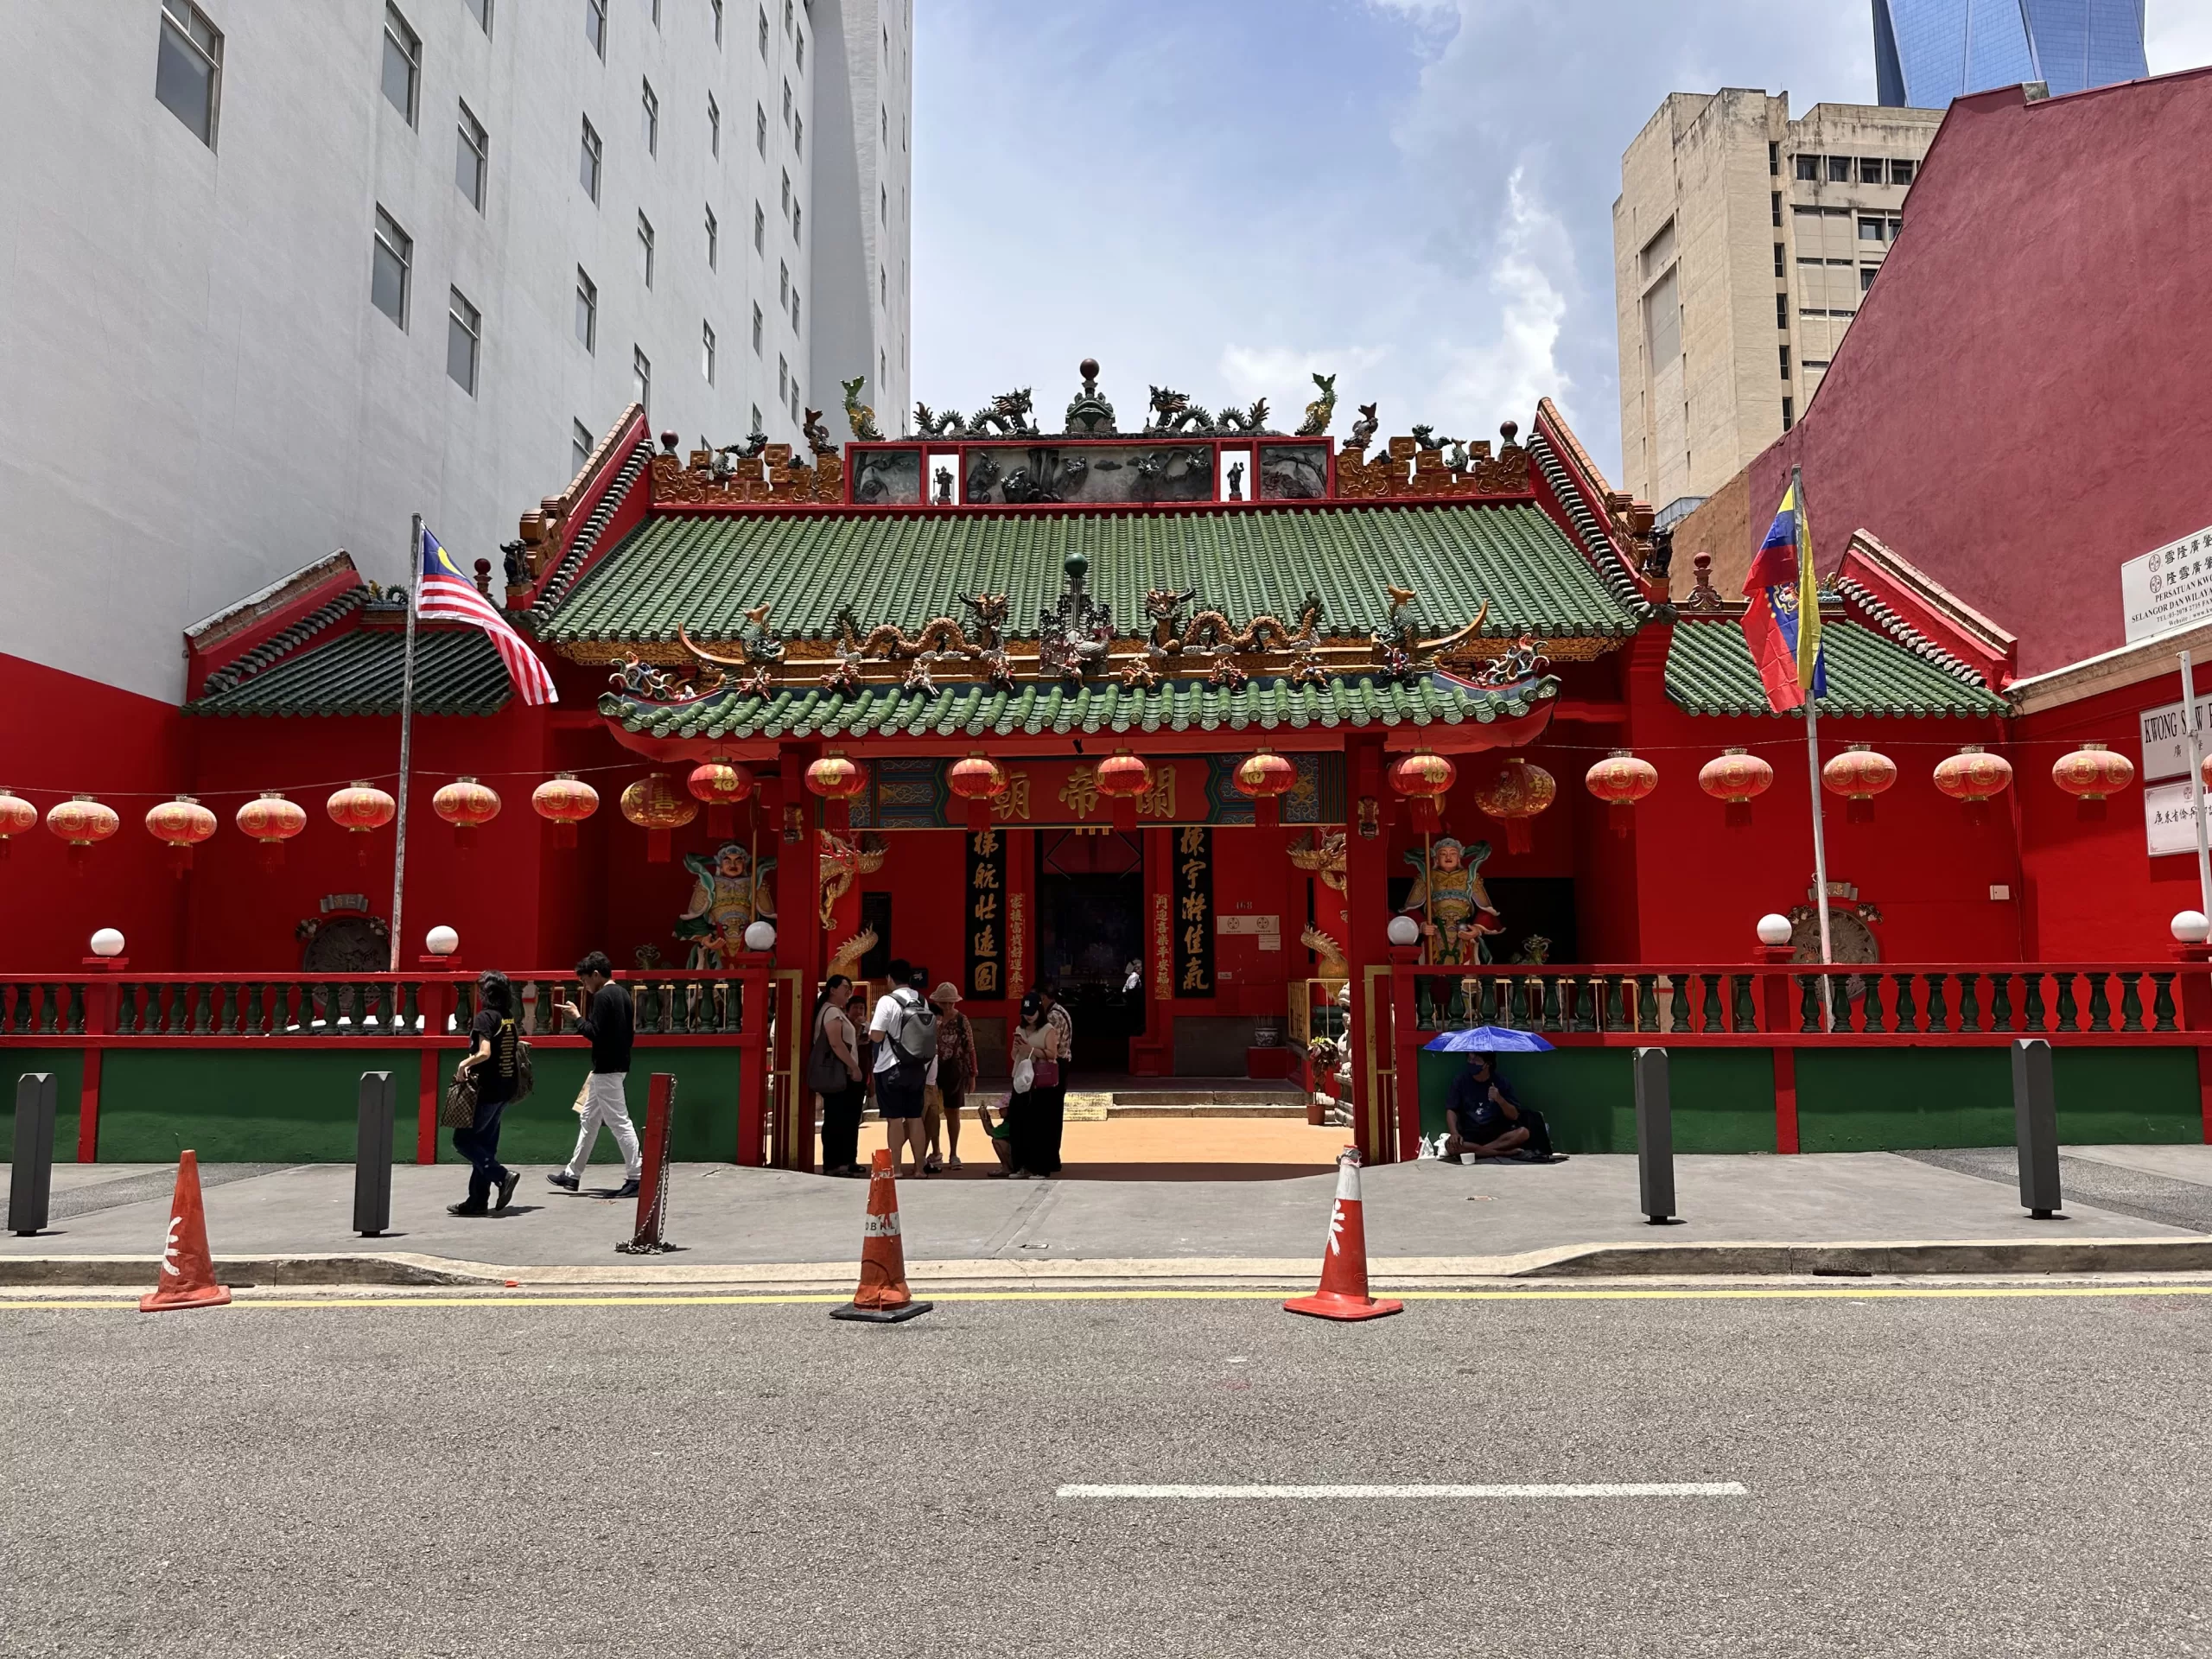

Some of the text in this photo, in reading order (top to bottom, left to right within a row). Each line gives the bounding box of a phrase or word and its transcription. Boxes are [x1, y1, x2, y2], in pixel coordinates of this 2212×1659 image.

[2155, 580, 2196, 602] PERSATUAN
[2132, 603, 2168, 623] SELANGOR
[2170, 598, 2183, 609] DAN
[2169, 616, 2188, 626] Website
[2144, 712, 2177, 743] KWONG
